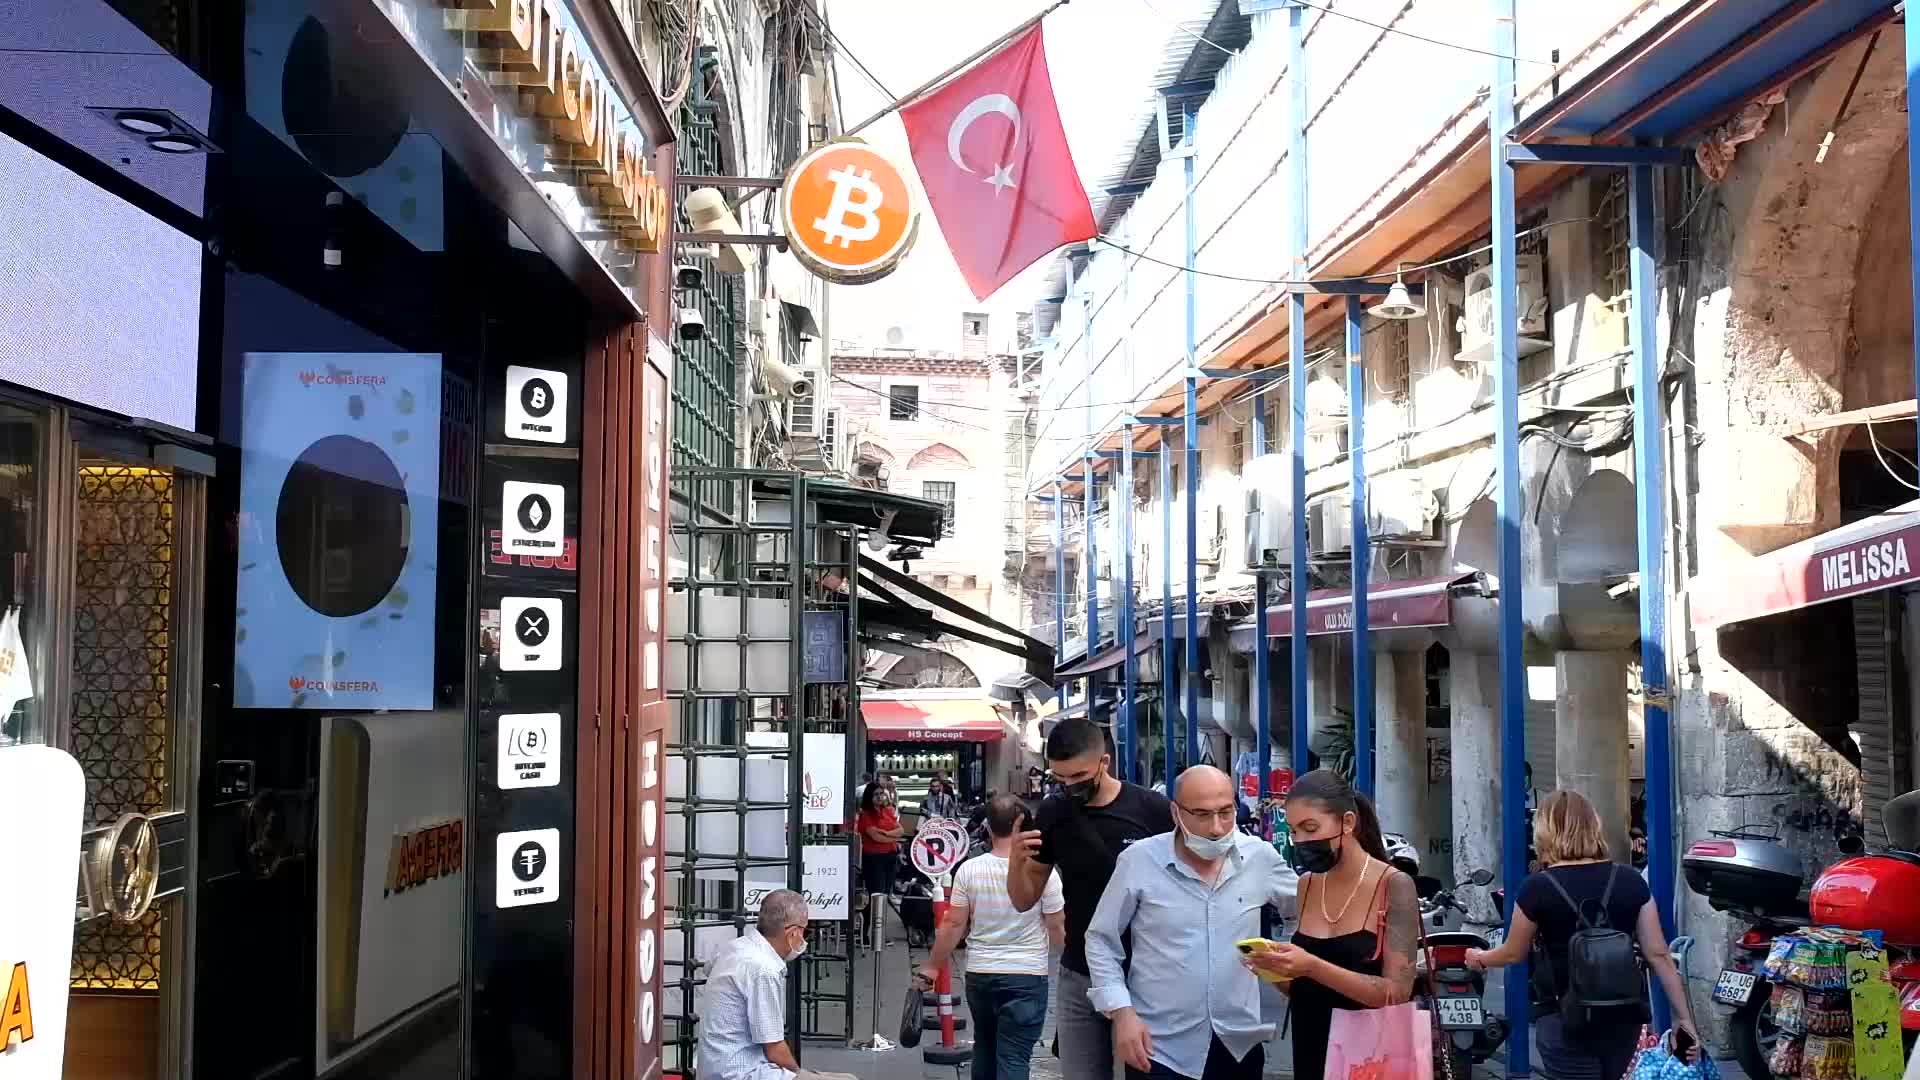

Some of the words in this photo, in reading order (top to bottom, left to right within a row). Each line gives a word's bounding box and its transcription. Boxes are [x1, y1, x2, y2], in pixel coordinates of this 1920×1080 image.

[908, 730, 921, 739] HS
[924, 730, 964, 740] Concept
[817, 867, 838, 876] 1922
[1720, 972, 1732, 984] 34
[1739, 975, 1754, 988] UG
[1454, 999, 1479, 1012] CLD
[1449, 1012, 1473, 1024] 438
